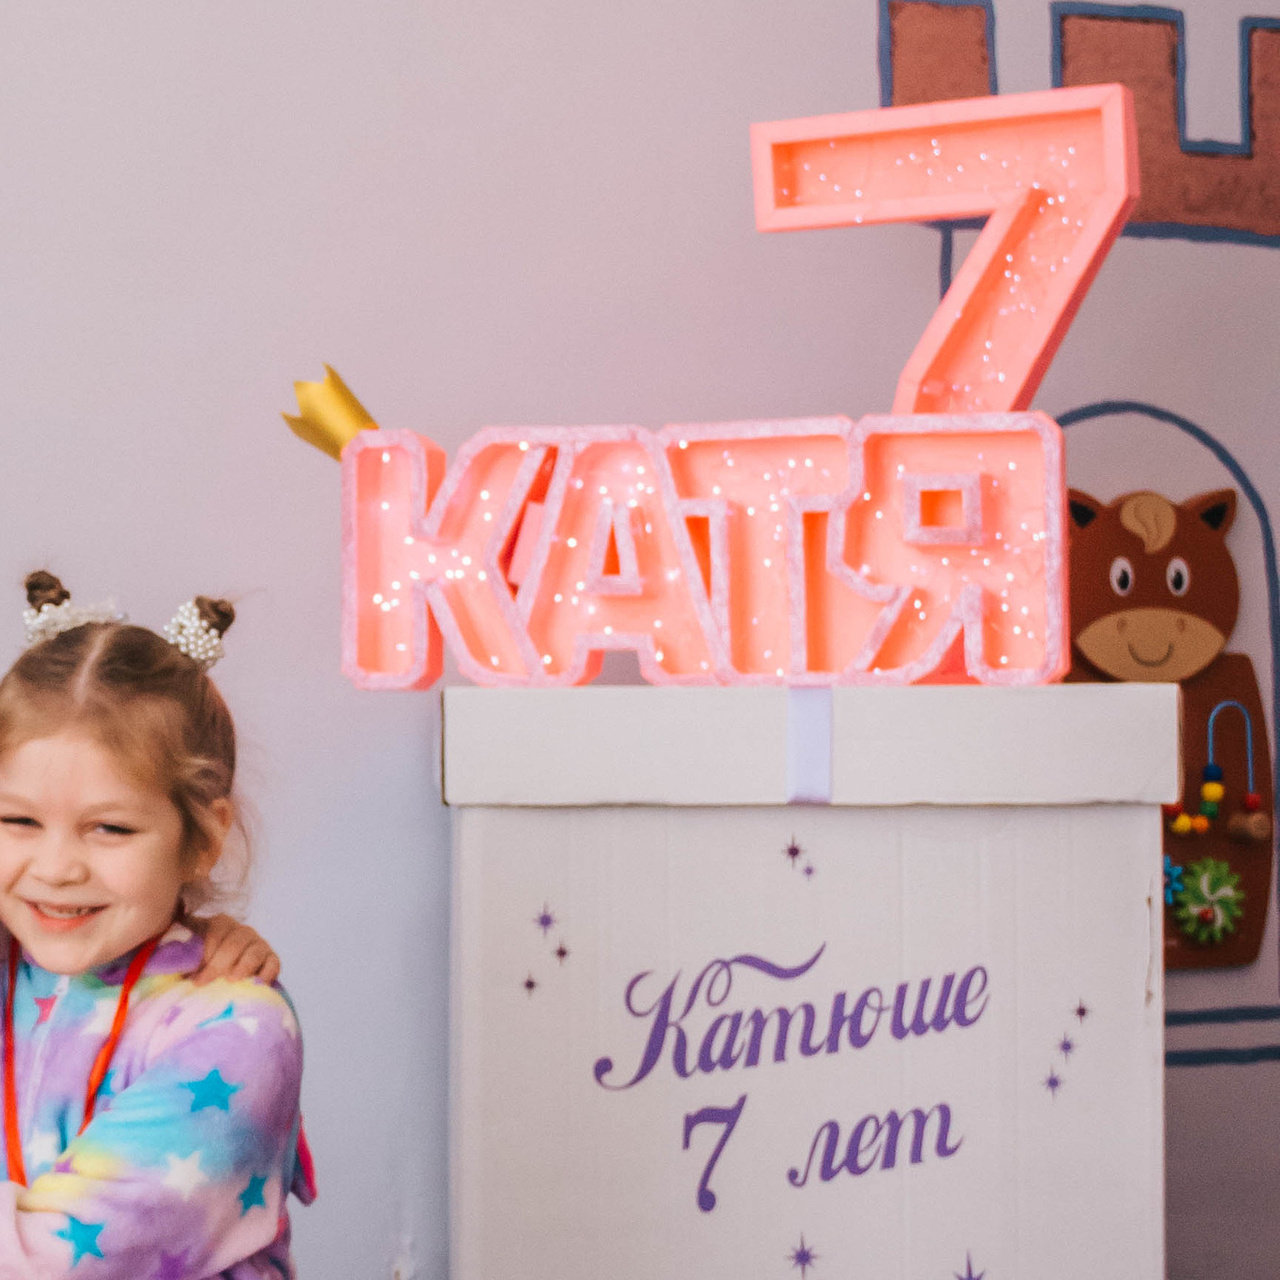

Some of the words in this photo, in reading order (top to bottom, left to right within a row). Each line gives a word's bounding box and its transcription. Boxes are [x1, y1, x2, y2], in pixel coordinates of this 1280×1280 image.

[750, 83, 1140, 414] 7
[341, 412, 1070, 691] КАТЯ
[592, 941, 991, 1091] Катюше
[680, 1093, 749, 1214] 7
[786, 1102, 964, 1188] лет
